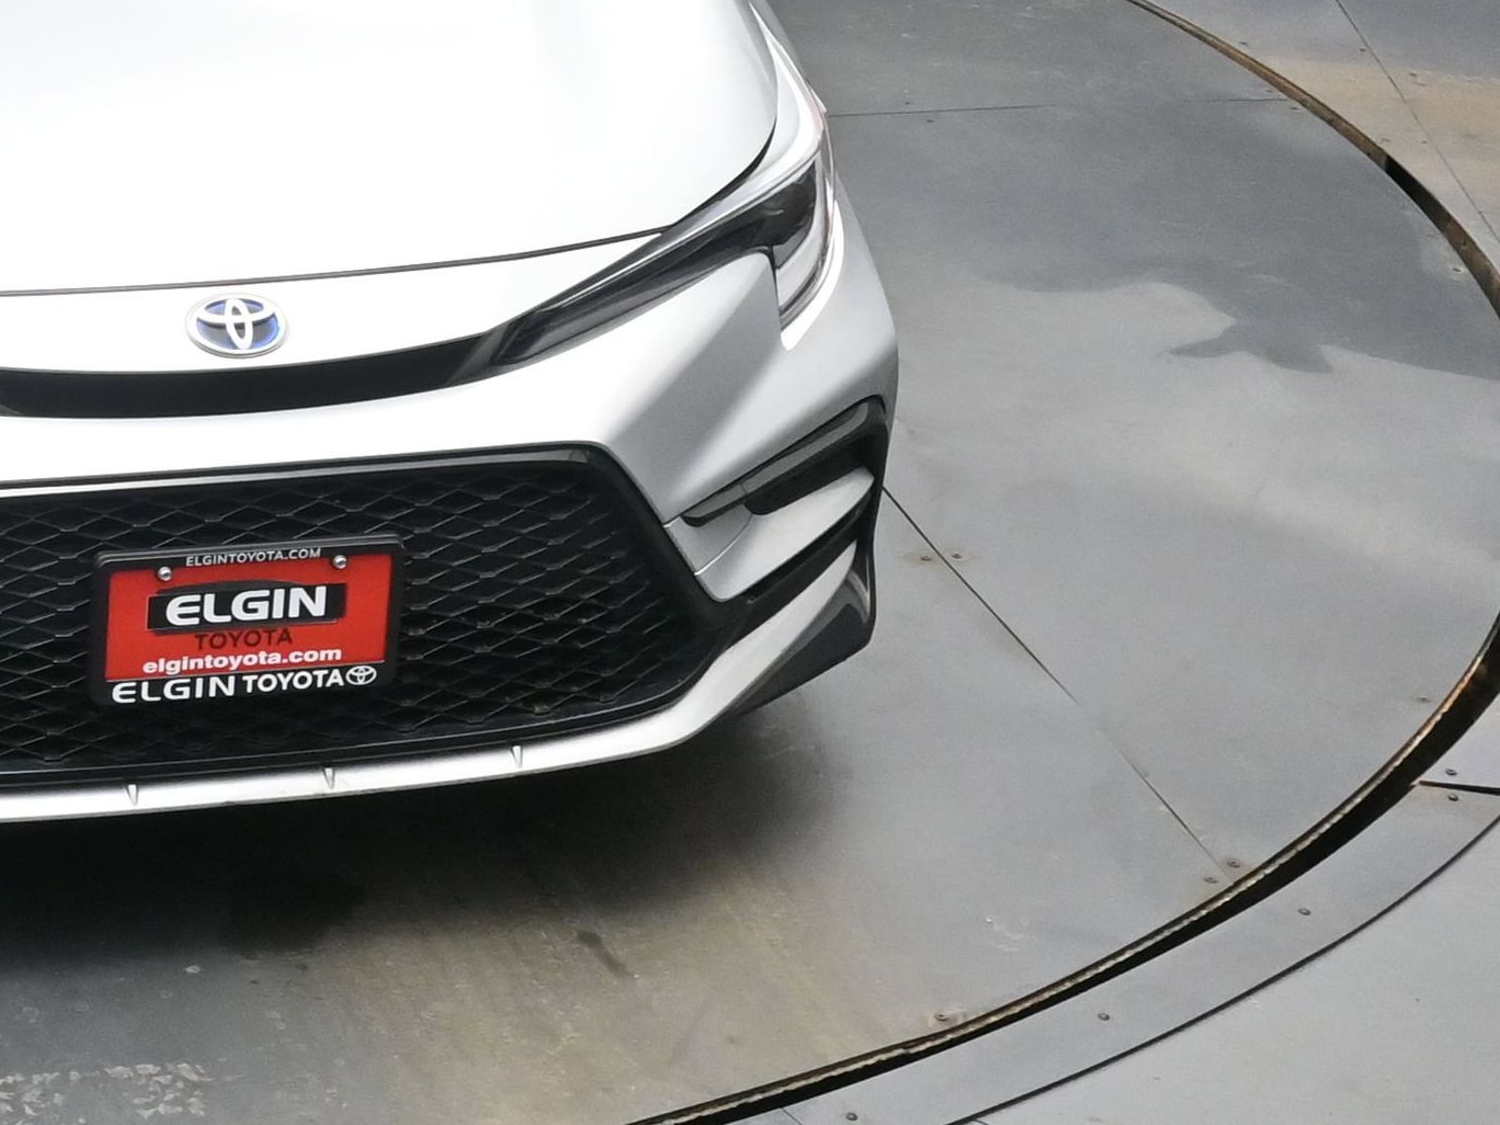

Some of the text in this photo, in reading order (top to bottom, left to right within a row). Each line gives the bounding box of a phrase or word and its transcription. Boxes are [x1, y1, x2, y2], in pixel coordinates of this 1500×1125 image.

[186, 548, 321, 567] ELGINTOYOTA.COM
[166, 586, 327, 626] ELGIN
[195, 627, 293, 650] TOYOTA
[143, 648, 342, 675] elgintoyota.com
[112, 669, 344, 704] ELGIN TOYOTA
